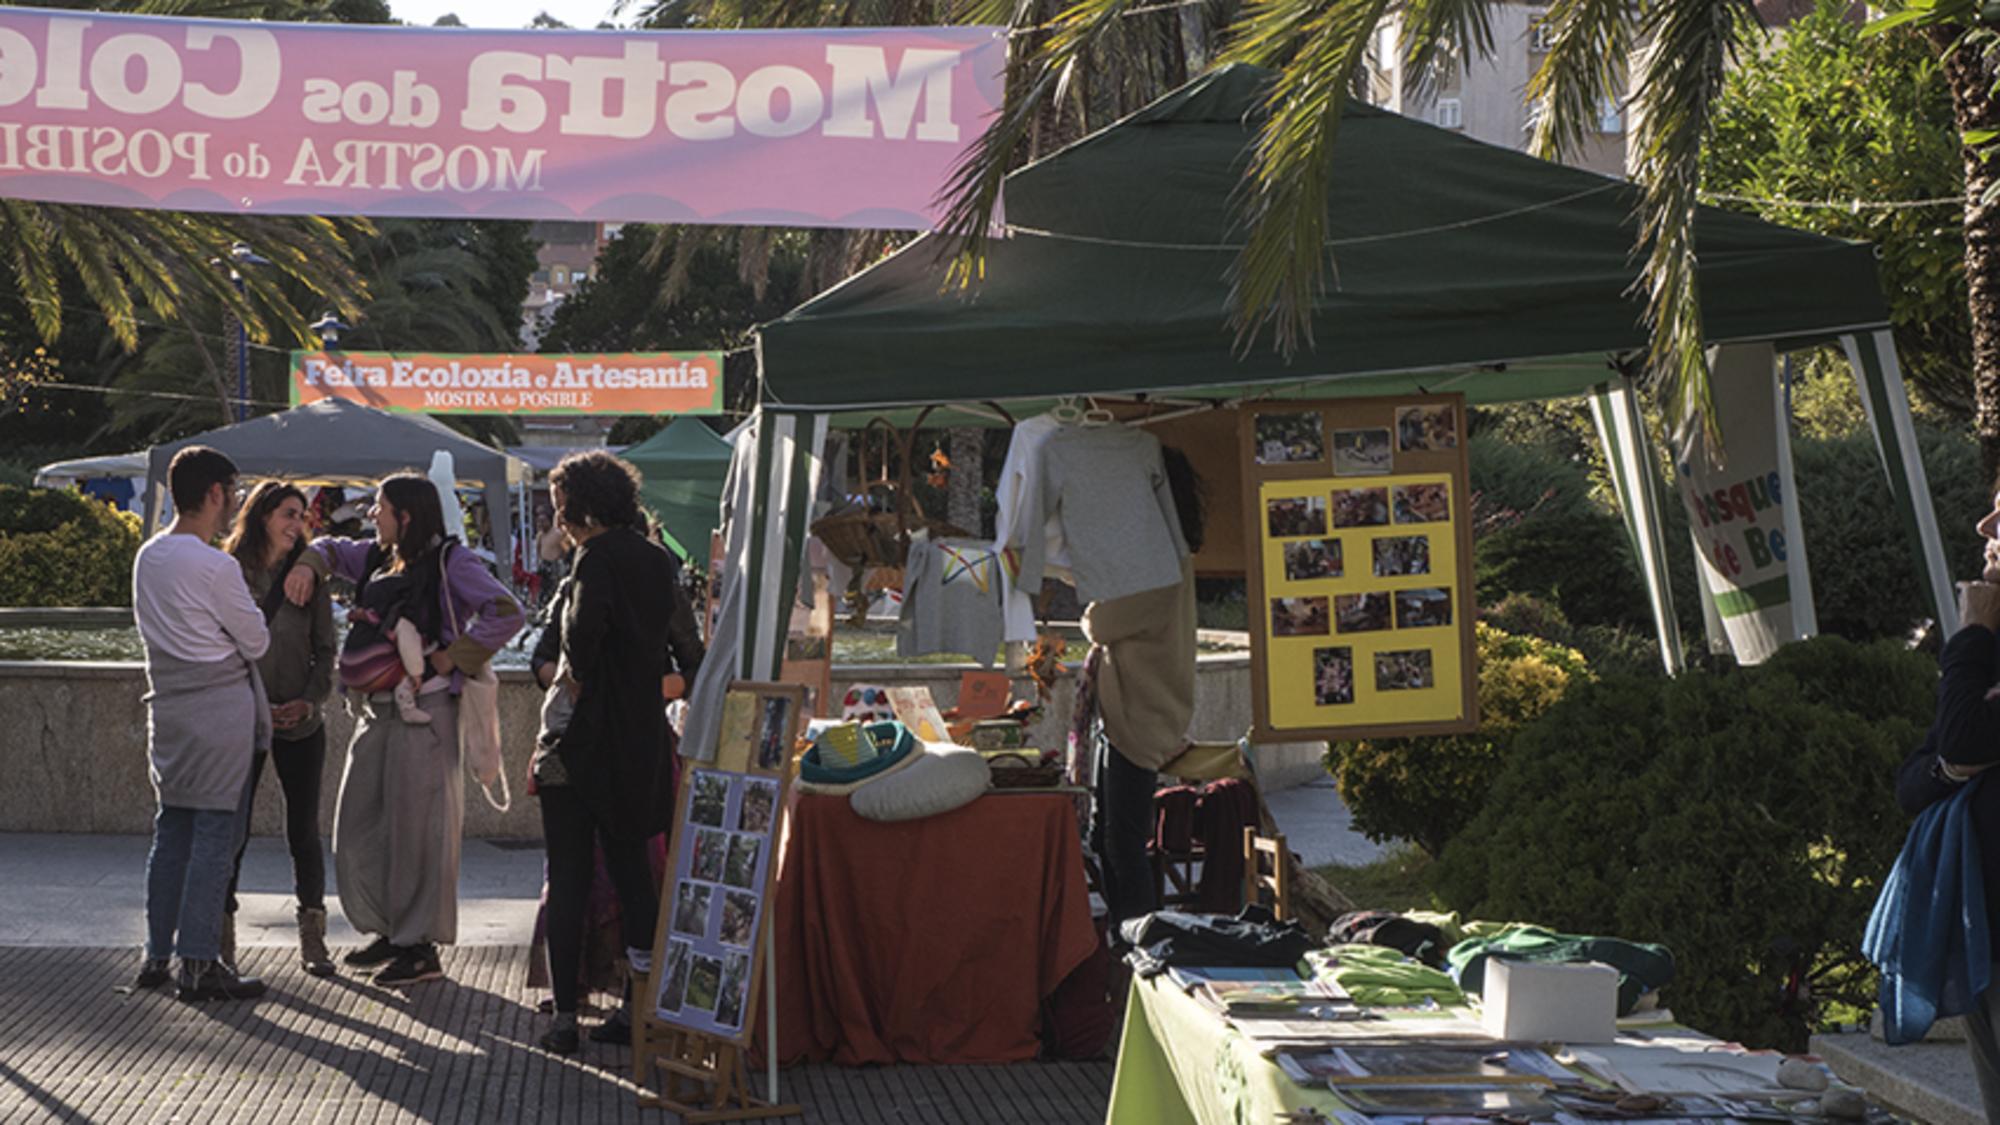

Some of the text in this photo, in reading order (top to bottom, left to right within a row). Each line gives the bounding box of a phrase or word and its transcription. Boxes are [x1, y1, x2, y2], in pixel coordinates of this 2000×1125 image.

[304, 359, 708, 388] Feira Ecoloxía e Artesanía
[424, 391, 497, 406] MOSTRA
[518, 391, 593, 407] POSIBLE
